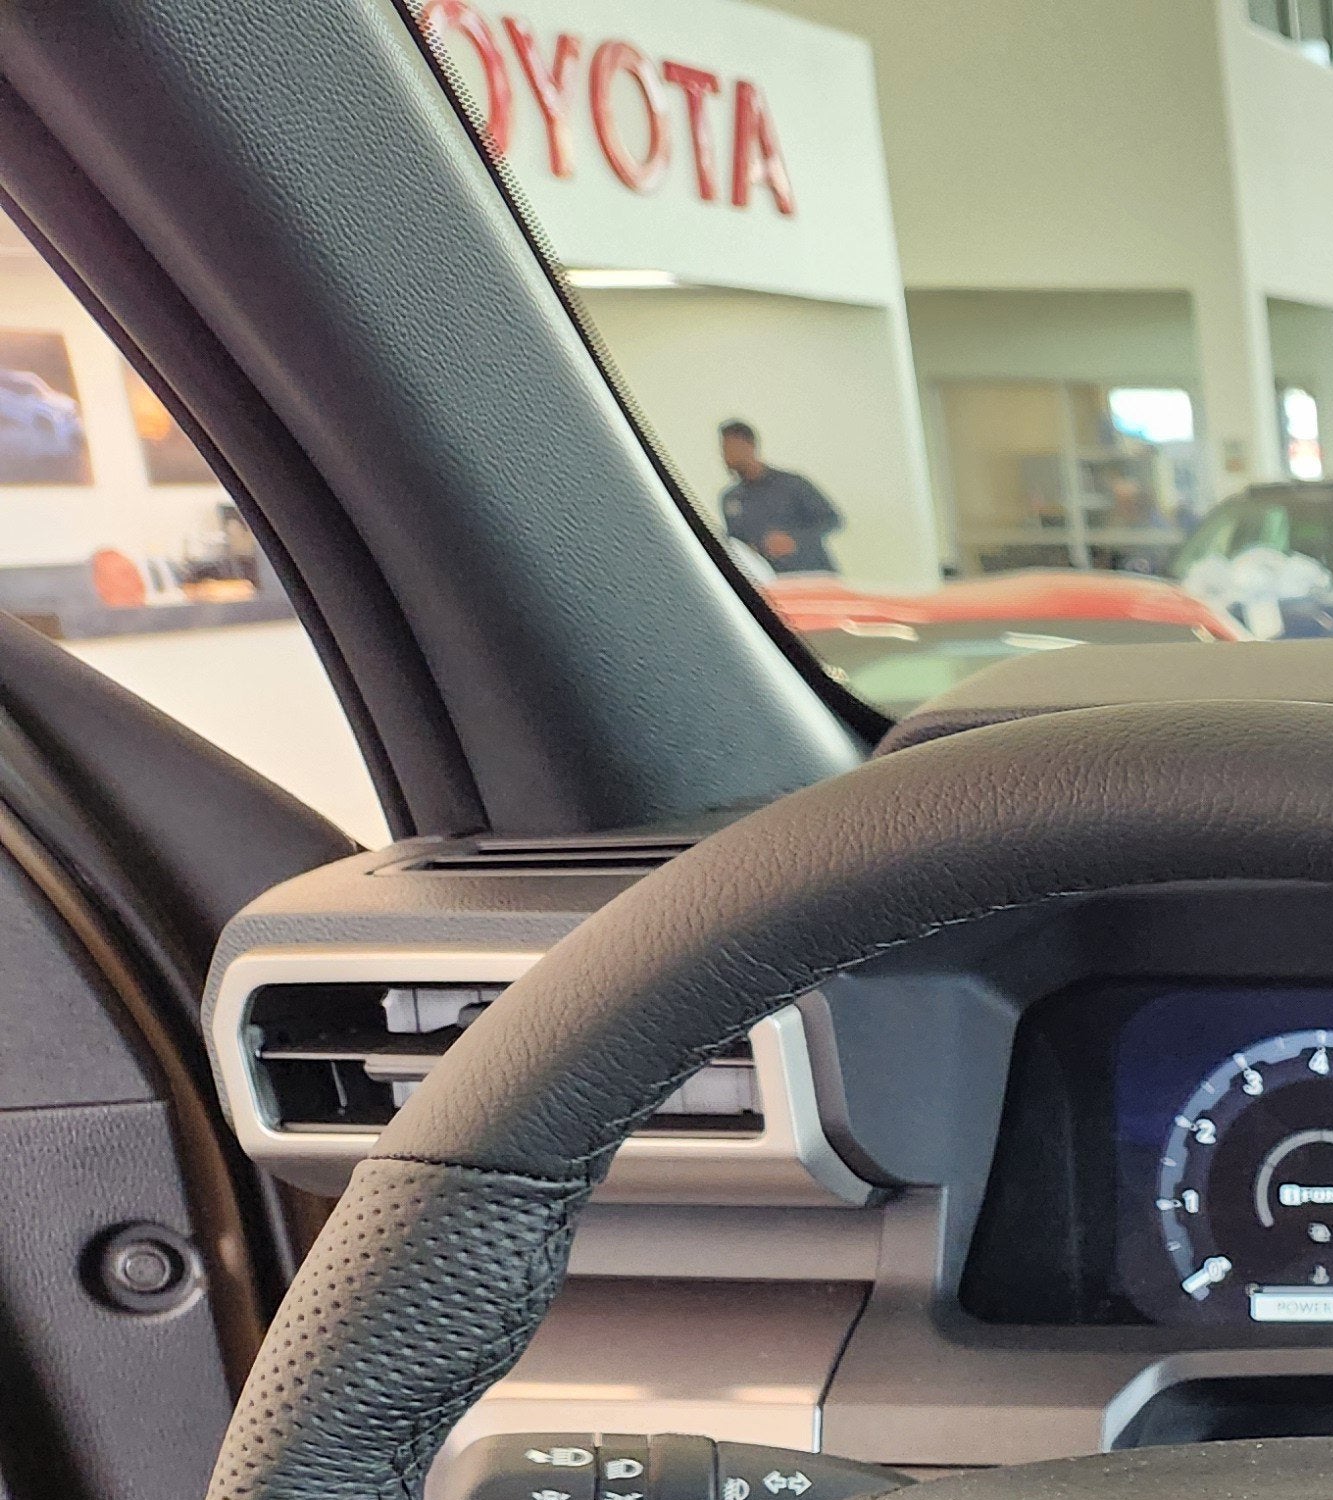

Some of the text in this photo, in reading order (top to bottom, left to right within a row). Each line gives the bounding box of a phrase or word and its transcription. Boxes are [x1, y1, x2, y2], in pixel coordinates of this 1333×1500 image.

[423, 0, 794, 216] OYOTA
[1309, 1051, 1330, 1075] 4
[1242, 1069, 1264, 1095] 3
[1195, 1118, 1217, 1144] 2
[1181, 1189, 1199, 1213] 1
[1277, 1302, 1332, 1314] POWER
